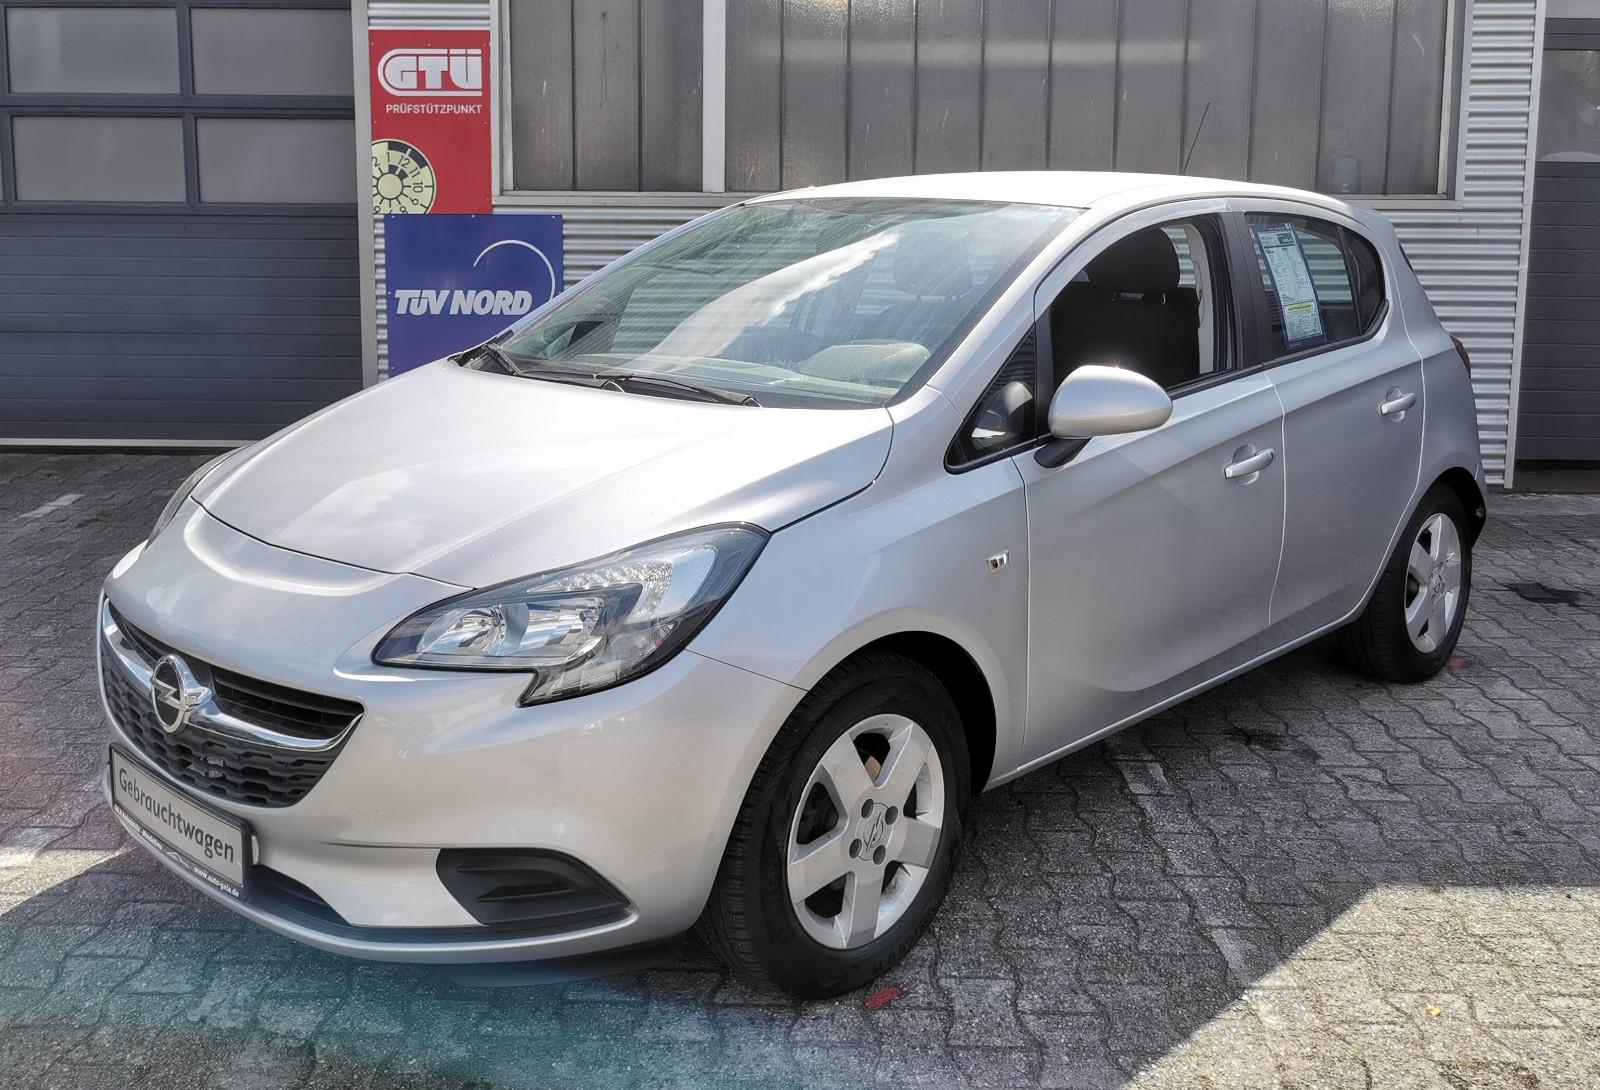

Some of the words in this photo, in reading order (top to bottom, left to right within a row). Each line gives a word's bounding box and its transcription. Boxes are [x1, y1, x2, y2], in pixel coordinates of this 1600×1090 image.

[379, 49, 483, 94] GTÜ
[386, 103, 483, 115] PRÜFSTÜTZPUNKT
[386, 152, 390, 163] 1
[398, 155, 411, 169] 12
[409, 167, 421, 178] 11
[412, 181, 424, 193] 10
[394, 289, 450, 316] TÜV
[450, 289, 533, 316] NORD
[119, 767, 235, 864] Gebrauchtwagen
